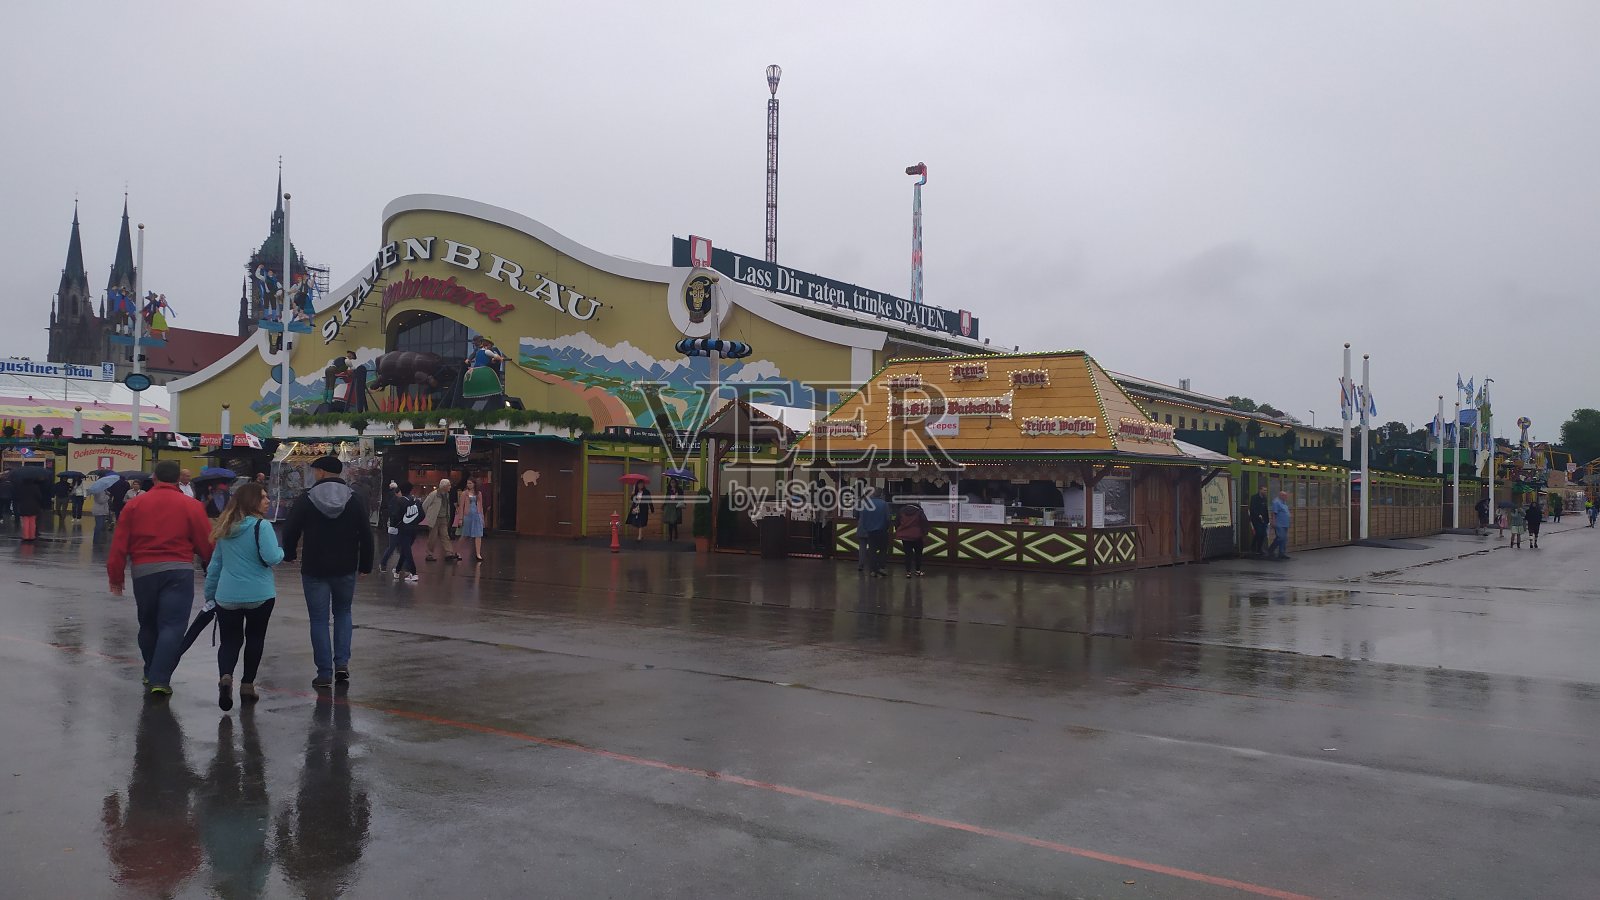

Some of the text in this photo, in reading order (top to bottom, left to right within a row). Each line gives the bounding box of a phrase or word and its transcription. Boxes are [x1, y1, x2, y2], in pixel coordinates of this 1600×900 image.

[320, 236, 603, 345] SPATENBRÄU
[734, 255, 949, 331] Lass Dir raten, trinke SPATEN.
[1059, 420, 1095, 432] Waffeln
